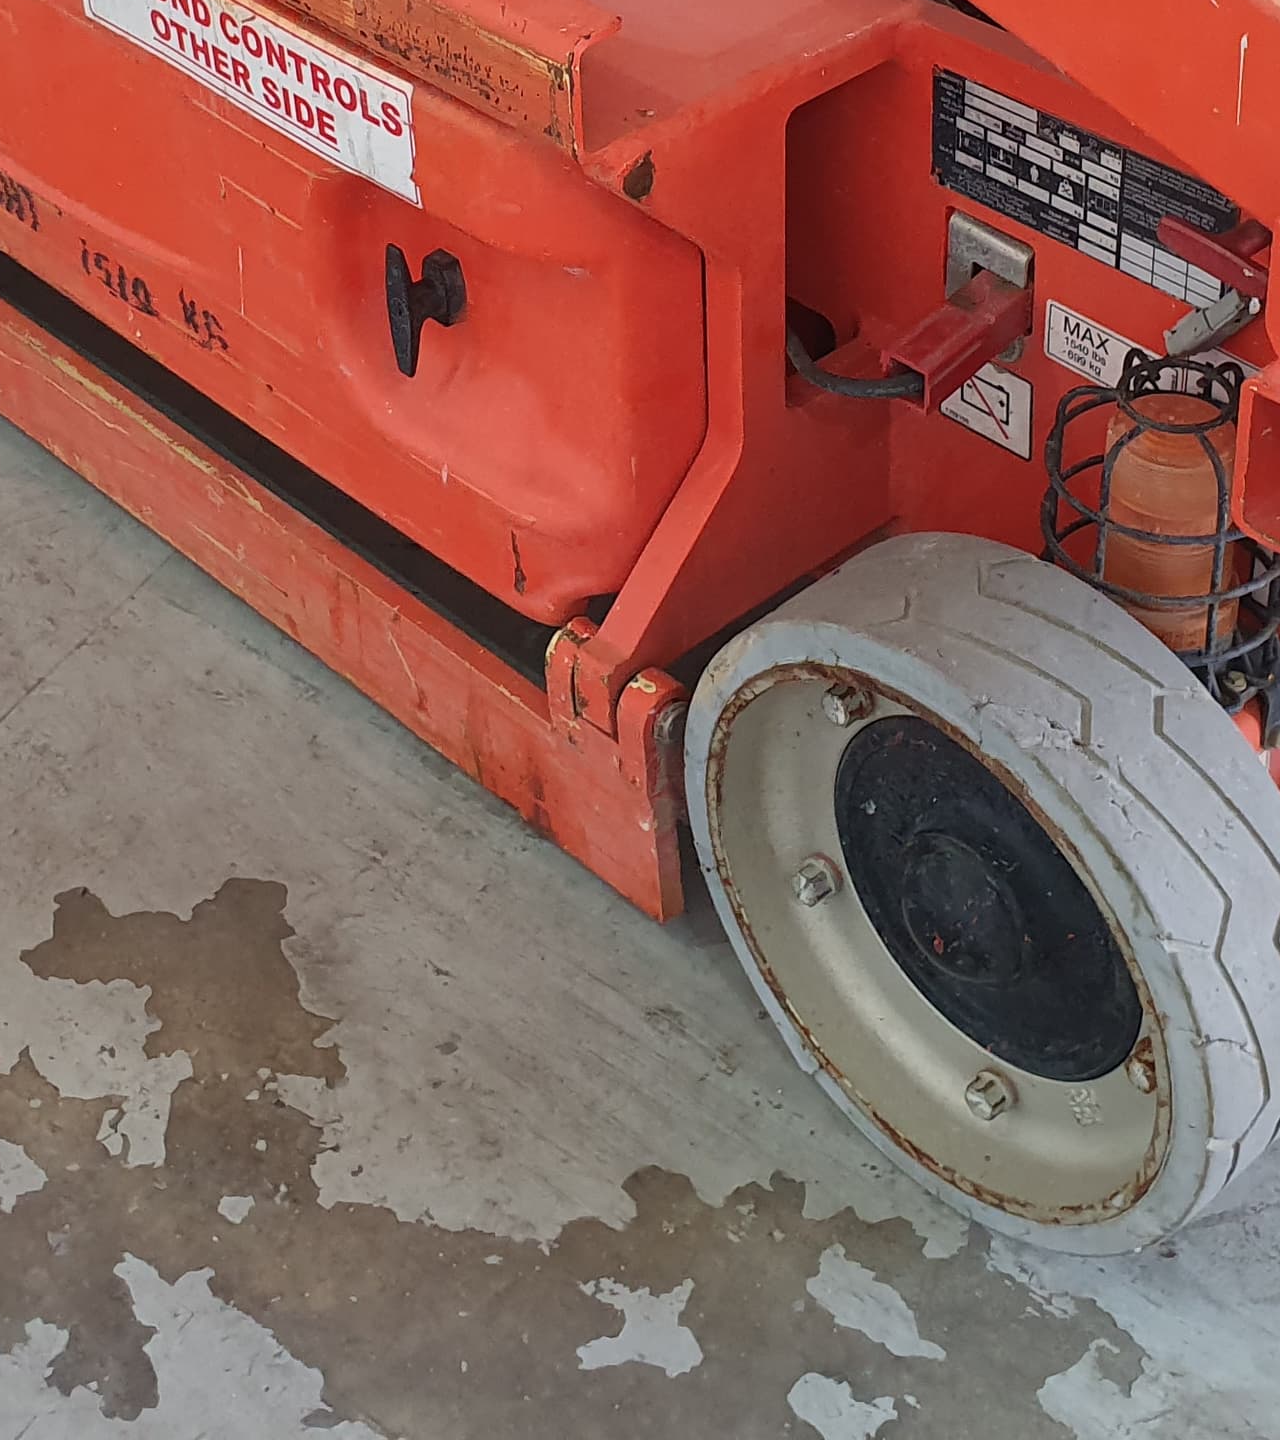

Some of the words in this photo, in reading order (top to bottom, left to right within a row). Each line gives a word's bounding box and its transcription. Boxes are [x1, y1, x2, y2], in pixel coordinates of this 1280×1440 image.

[150, 9, 254, 95] OTHER
[261, 76, 338, 145] SIDE
[219, 11, 404, 137] CONTROLS
[1063, 315, 1110, 355] MAX
